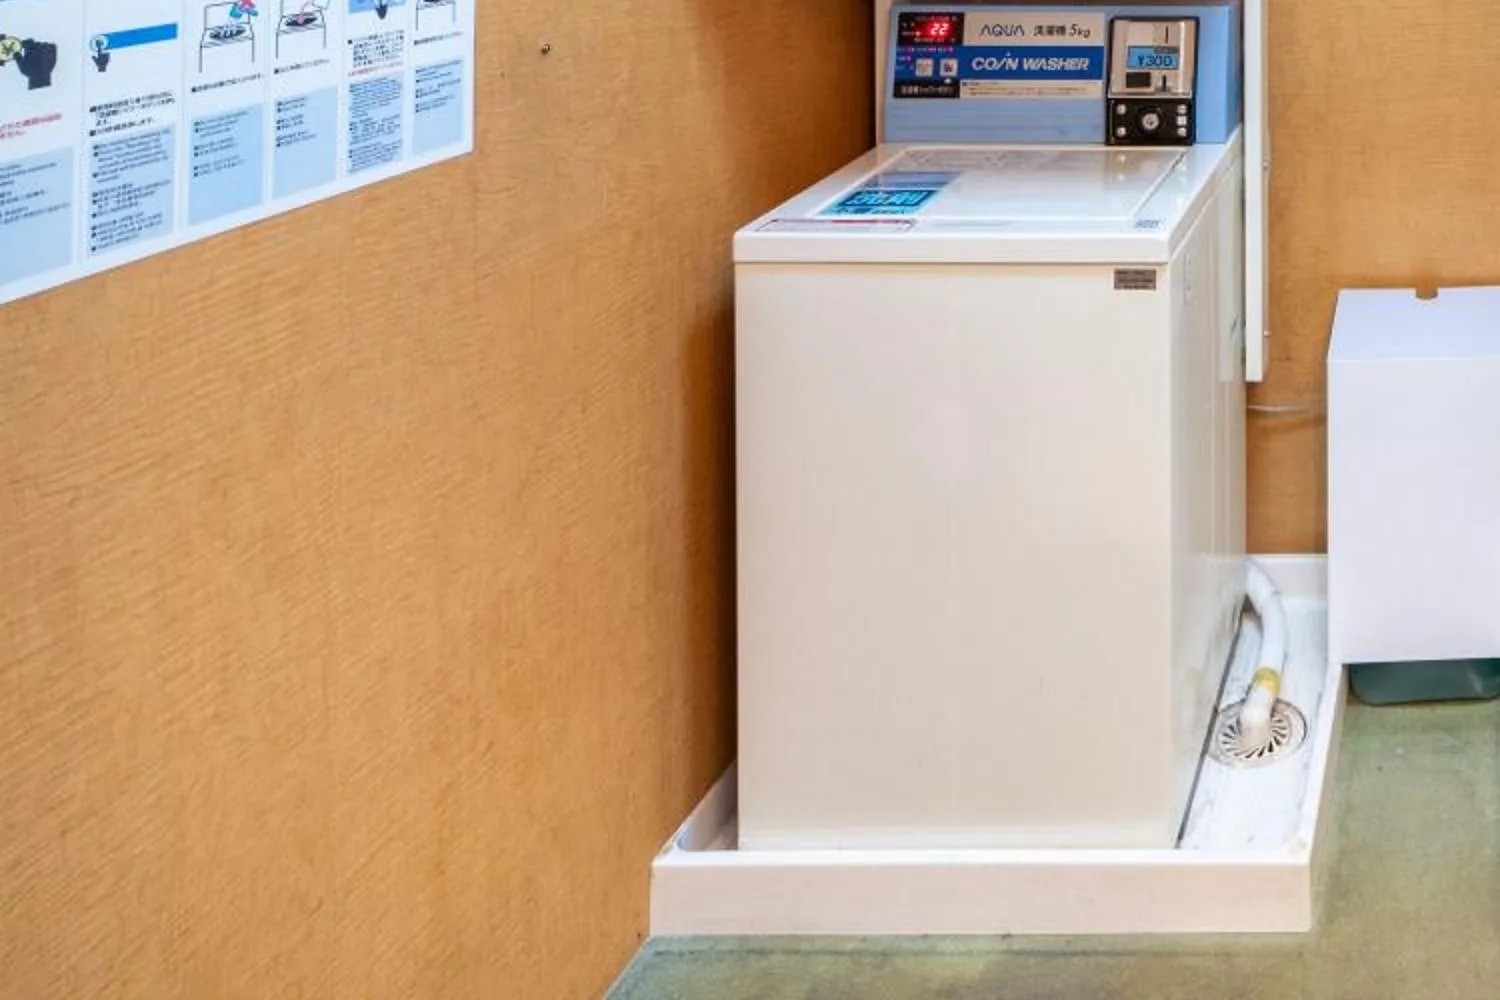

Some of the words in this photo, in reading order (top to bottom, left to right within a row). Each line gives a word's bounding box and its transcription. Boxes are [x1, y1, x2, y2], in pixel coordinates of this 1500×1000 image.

[930, 22, 950, 36] 22
[980, 23, 1025, 36] AQUA
[1033, 24, 1067, 37] 洗濯機
[1068, 23, 1091, 38] 5kg
[1023, 57, 1090, 71] WASHER
[1137, 54, 1173, 67] ¥300
